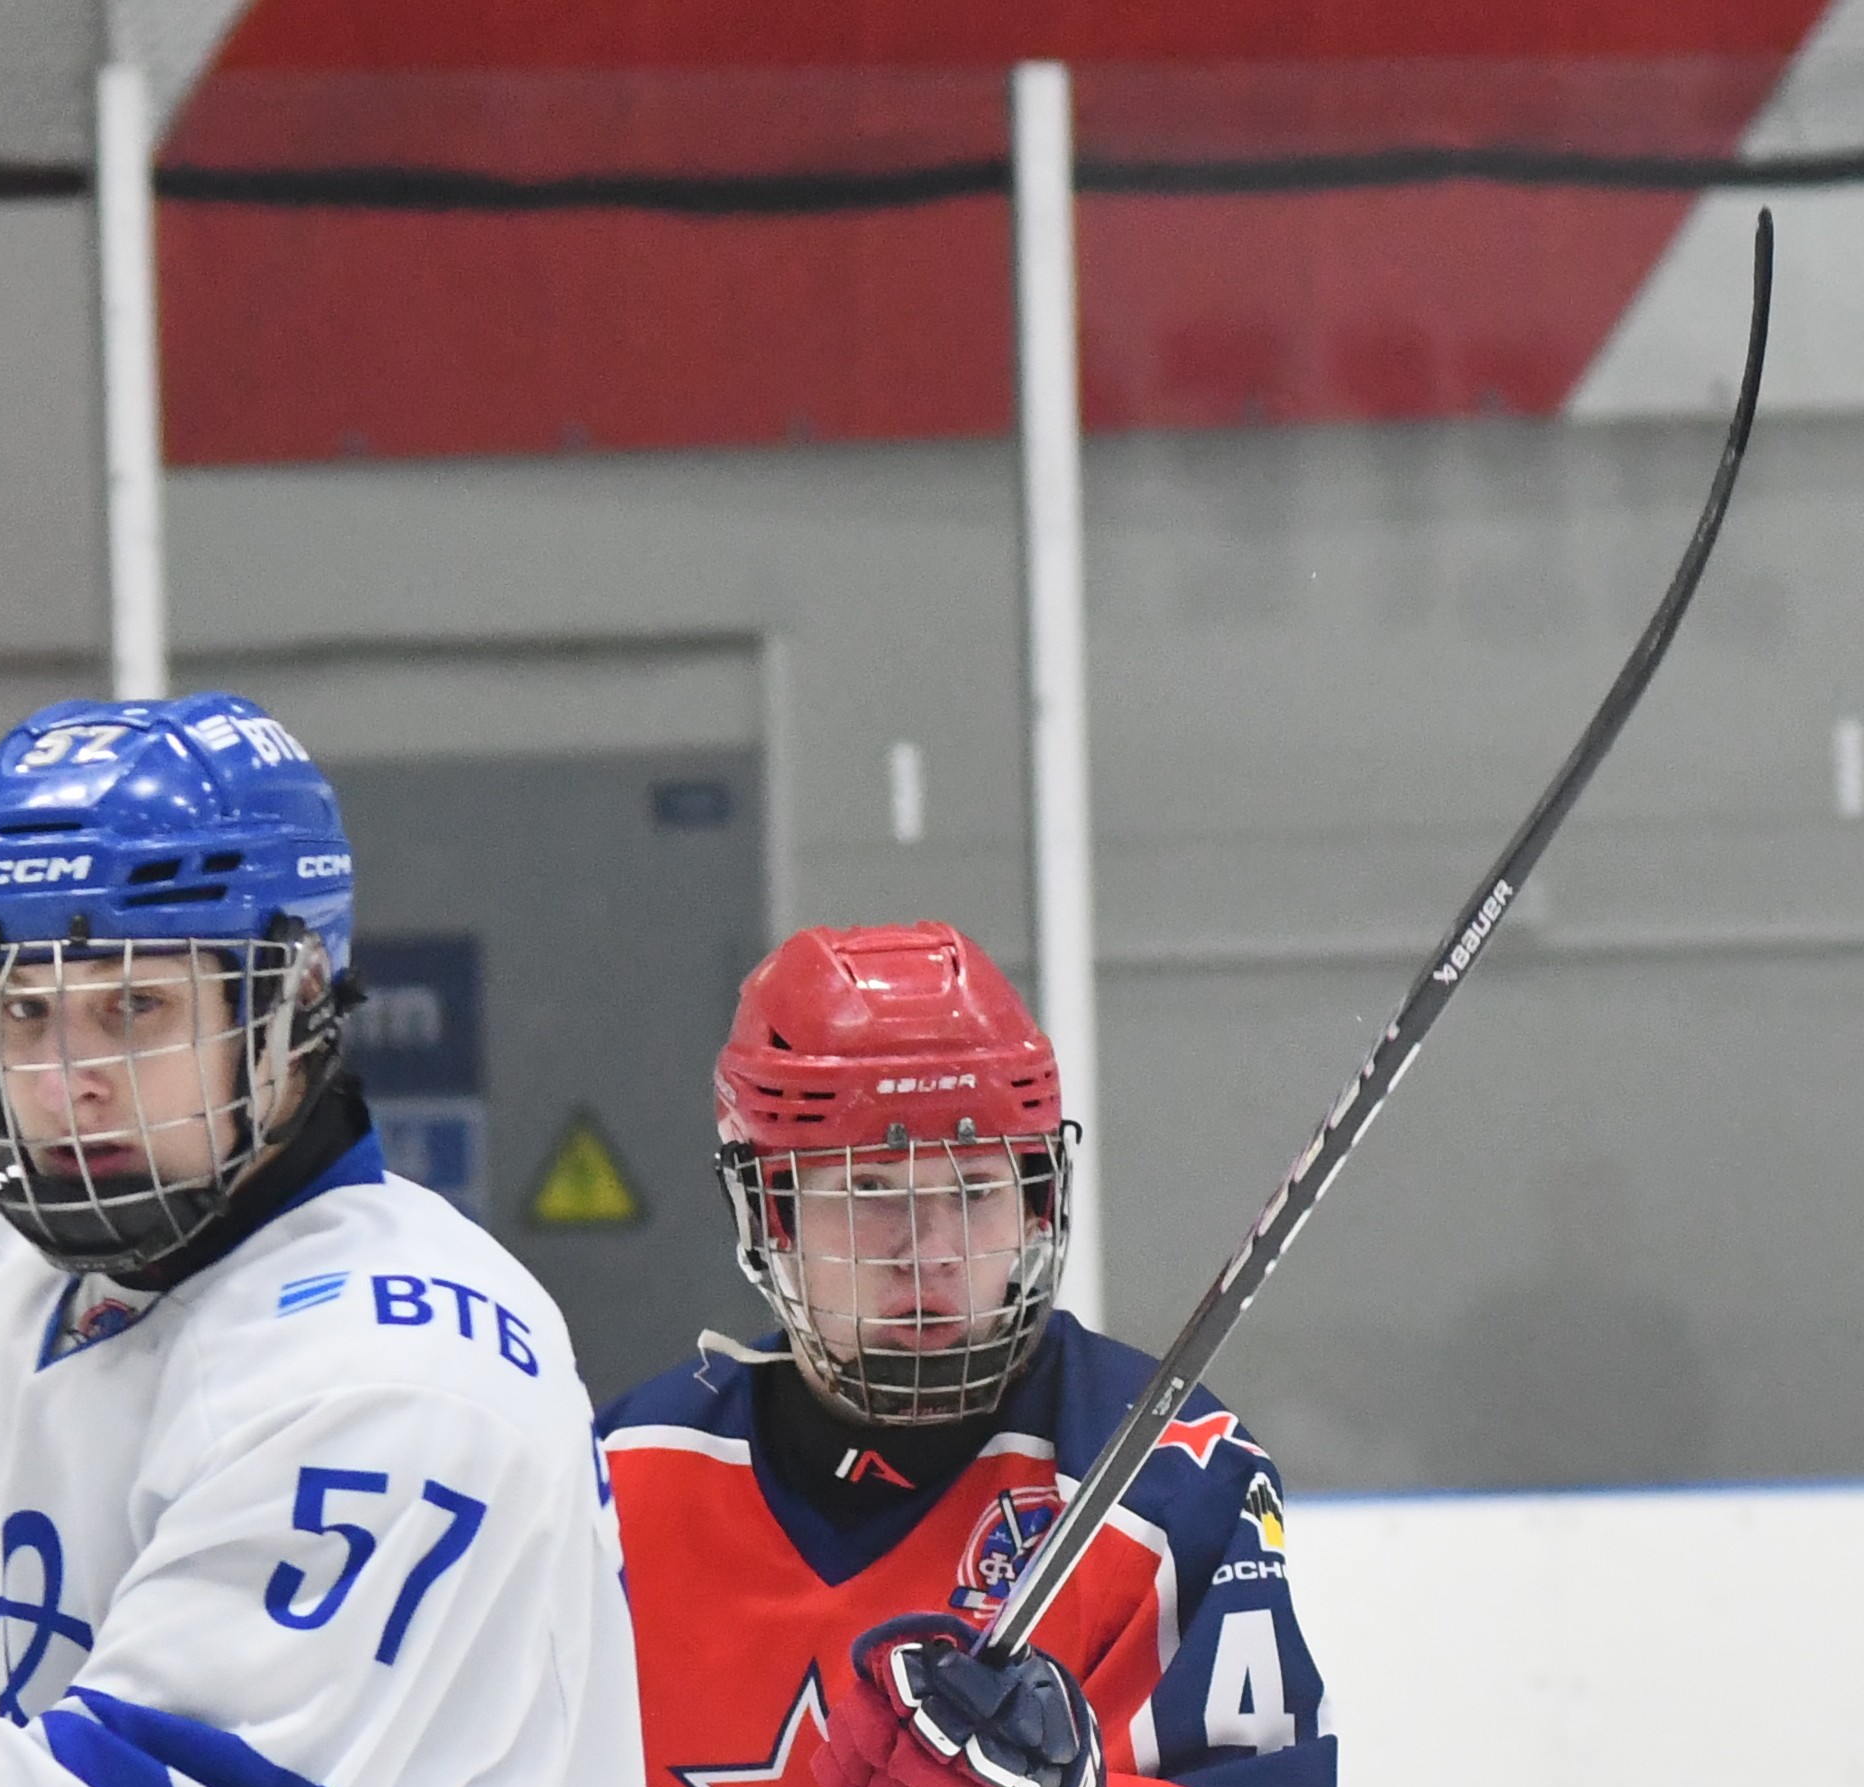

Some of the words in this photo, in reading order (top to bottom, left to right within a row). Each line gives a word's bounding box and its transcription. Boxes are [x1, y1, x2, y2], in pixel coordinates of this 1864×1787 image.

[297, 855, 352, 878] CCM
[370, 1274, 539, 1378] ВТБ
[264, 1466, 488, 1667] 57
[1203, 1608, 1298, 1757] 4
